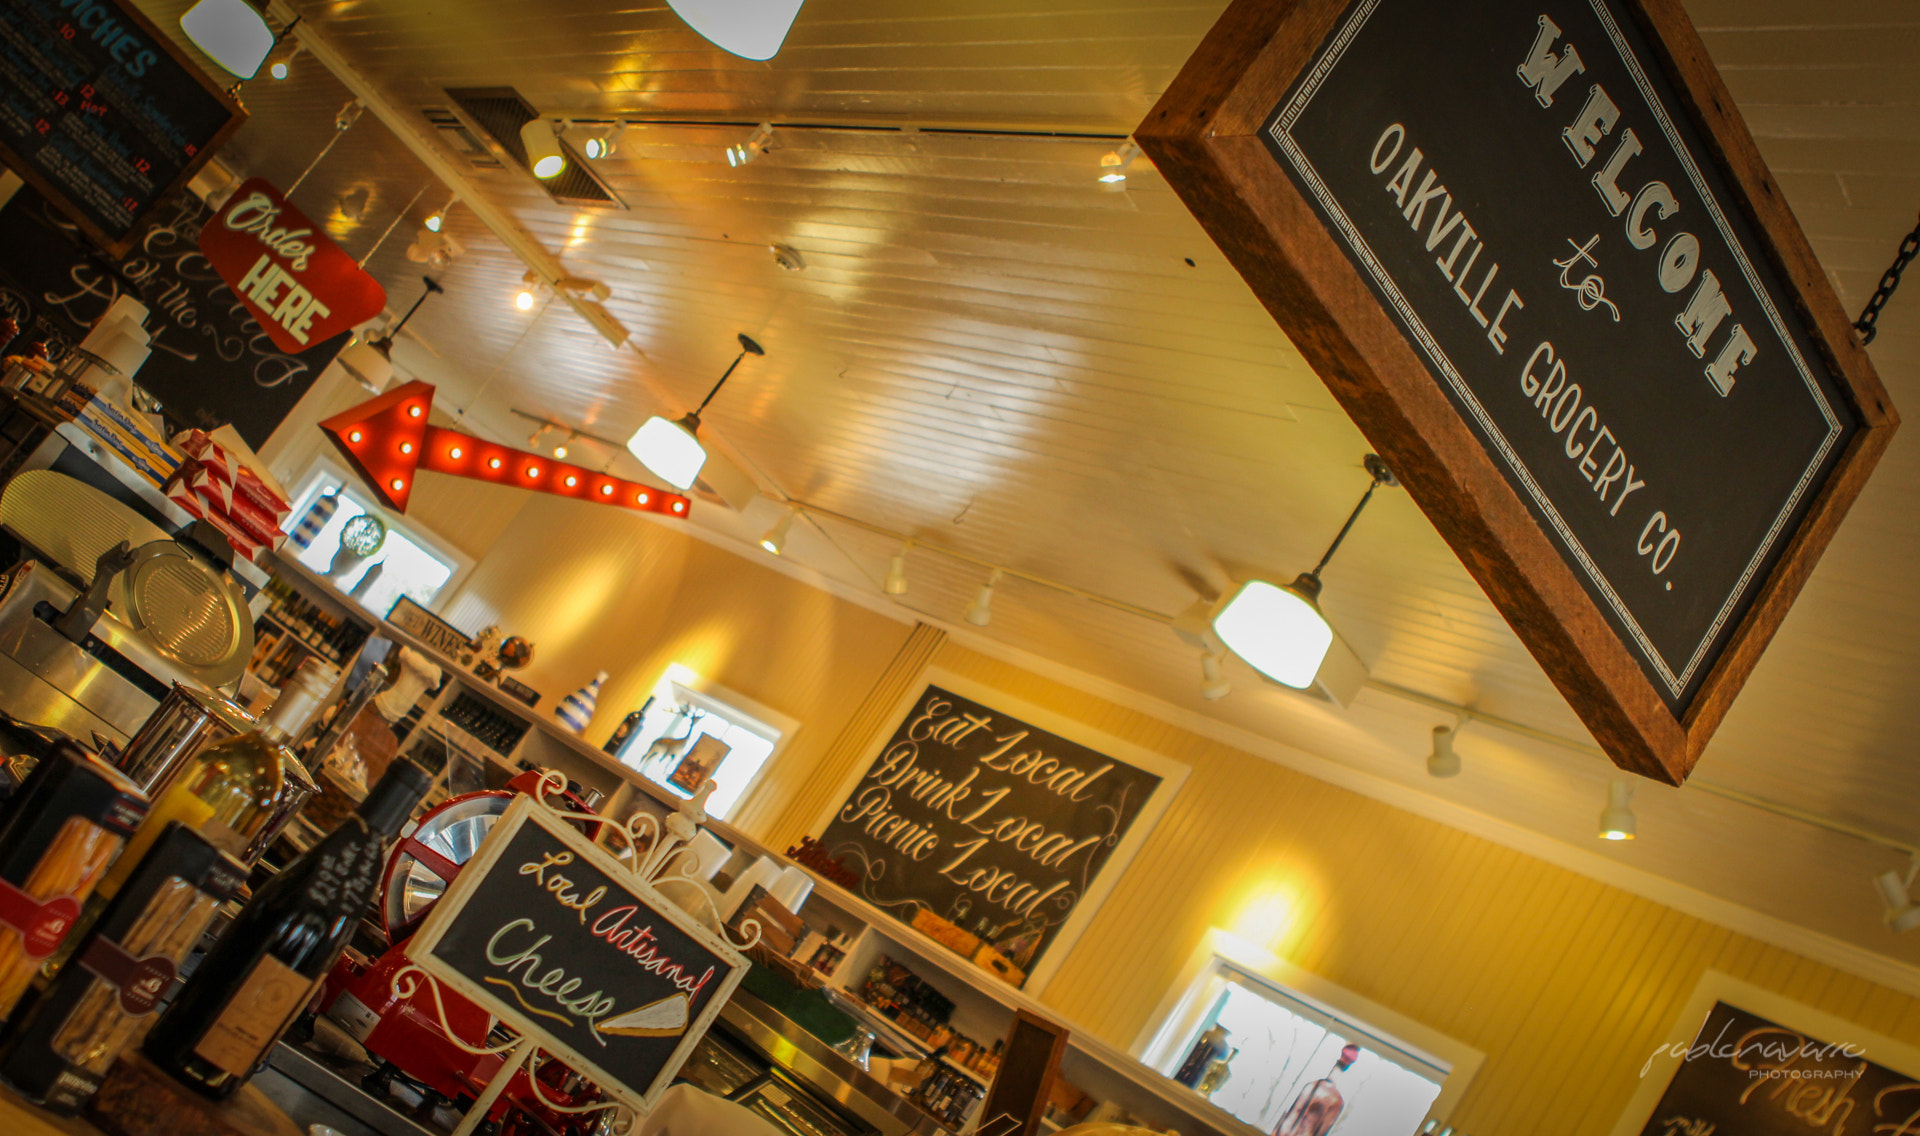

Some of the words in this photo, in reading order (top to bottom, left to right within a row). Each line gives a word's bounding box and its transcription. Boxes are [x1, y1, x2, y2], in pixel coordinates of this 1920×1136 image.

[224, 191, 316, 271] Order
[1516, 13, 1758, 398] WELCOME
[237, 253, 331, 346] HERE
[1552, 234, 1621, 322] to
[1370, 123, 1525, 356] OAKVILLE
[1520, 341, 1645, 517] GROCERY
[1637, 510, 1681, 592] CO.
[421, 619, 465, 662] WINES
[867, 740, 980, 820] Drink
[960, 787, 1101, 870] Local
[908, 696, 993, 750] Eat
[979, 730, 1115, 802] Local
[840, 785, 940, 862] Picnic
[938, 836, 1071, 919] Local
[486, 917, 616, 1047] Cheese
[518, 851, 608, 926] Local
[591, 904, 715, 1008] Artisanal
